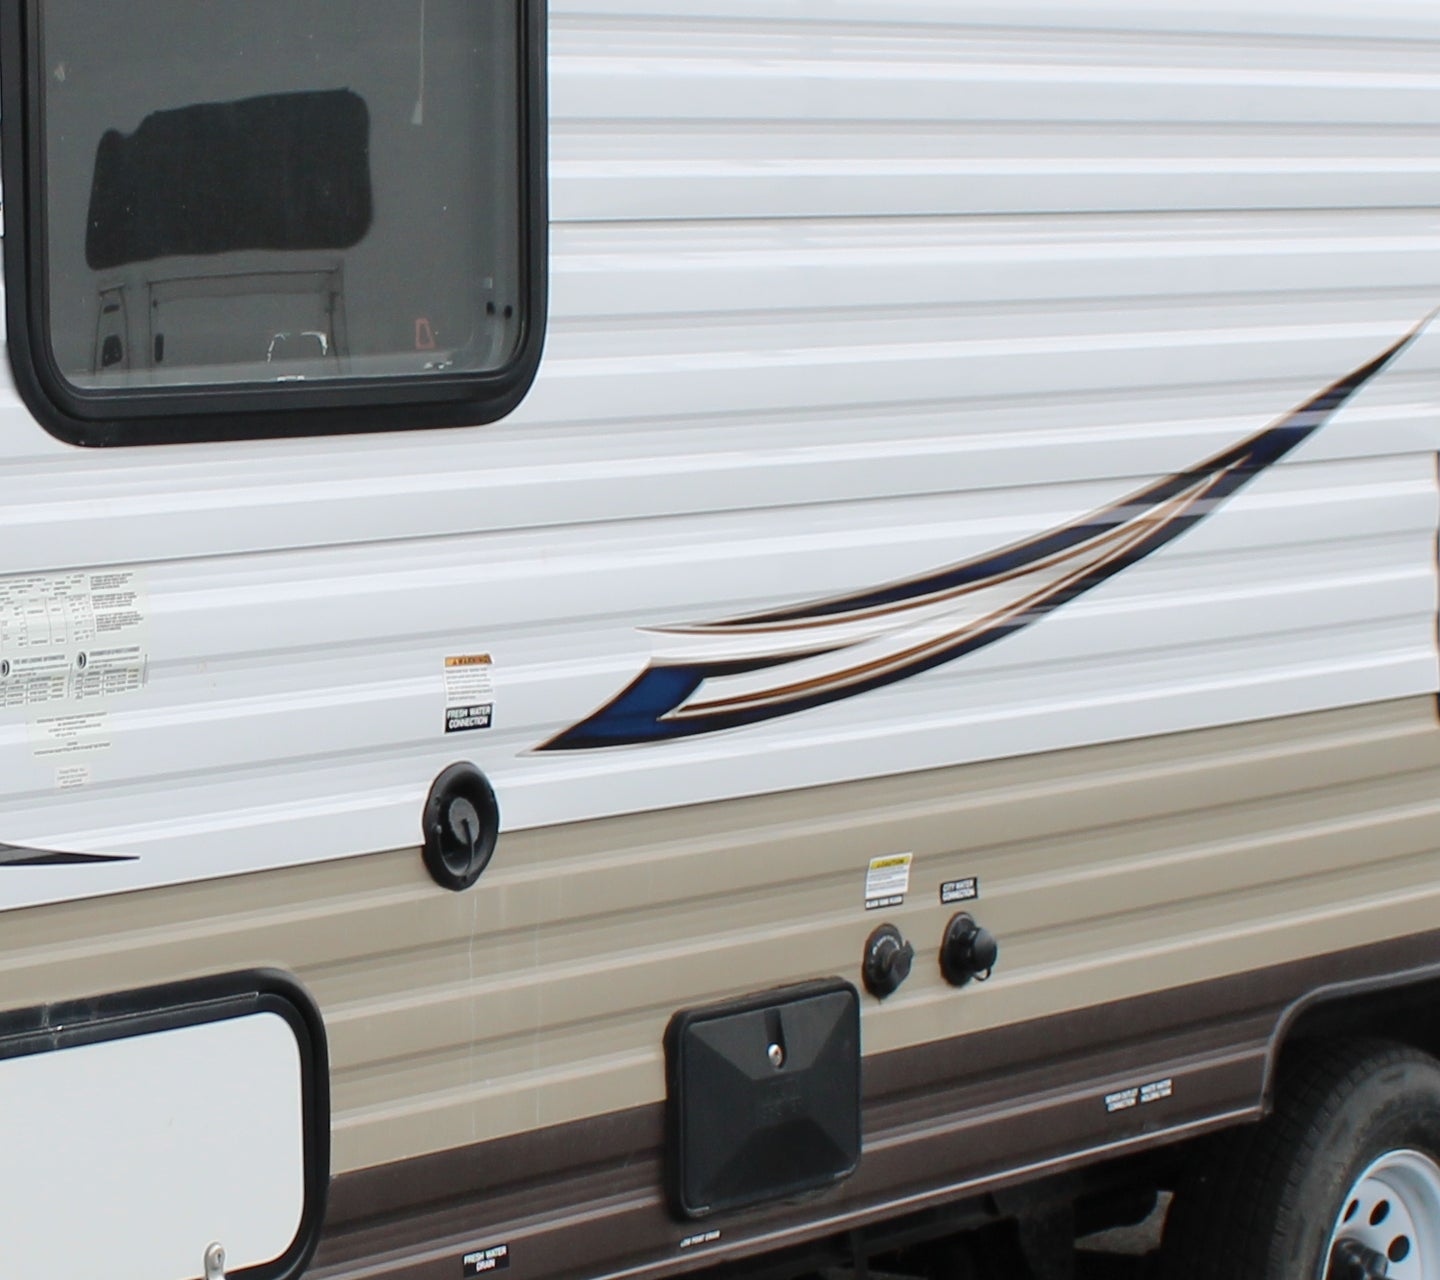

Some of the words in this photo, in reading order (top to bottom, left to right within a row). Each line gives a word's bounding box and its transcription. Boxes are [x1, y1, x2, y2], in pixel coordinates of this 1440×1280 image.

[447, 708, 468, 719] FRESH
[469, 705, 491, 716] WATER
[448, 716, 488, 729] CONNECTION
